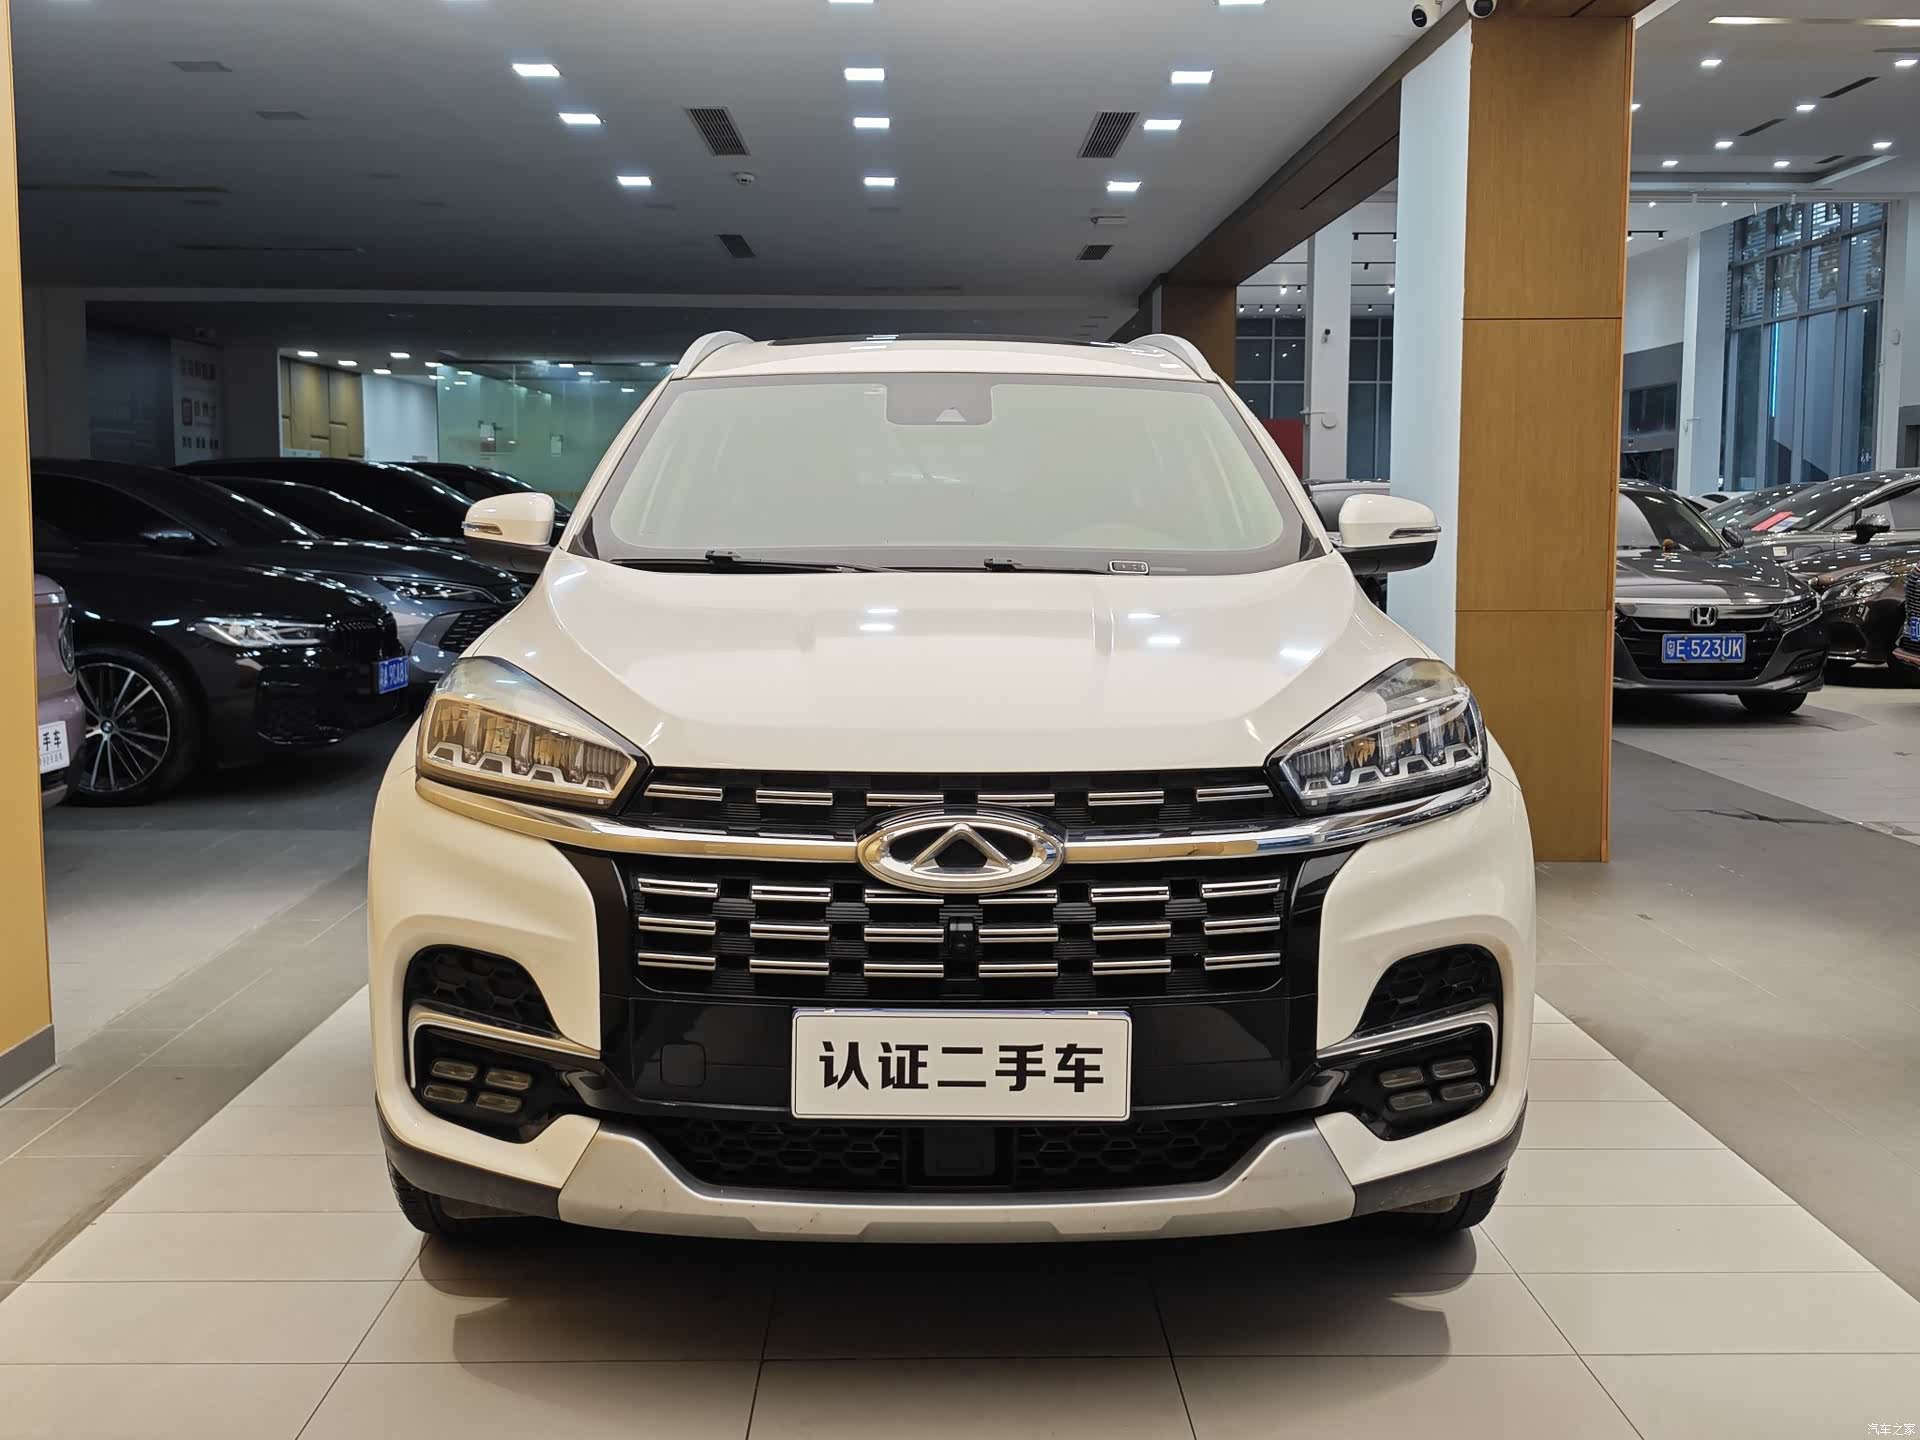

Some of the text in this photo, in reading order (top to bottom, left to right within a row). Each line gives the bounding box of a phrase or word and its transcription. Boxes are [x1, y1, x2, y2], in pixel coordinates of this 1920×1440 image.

[819, 1040, 1104, 1093] 认证二手车
